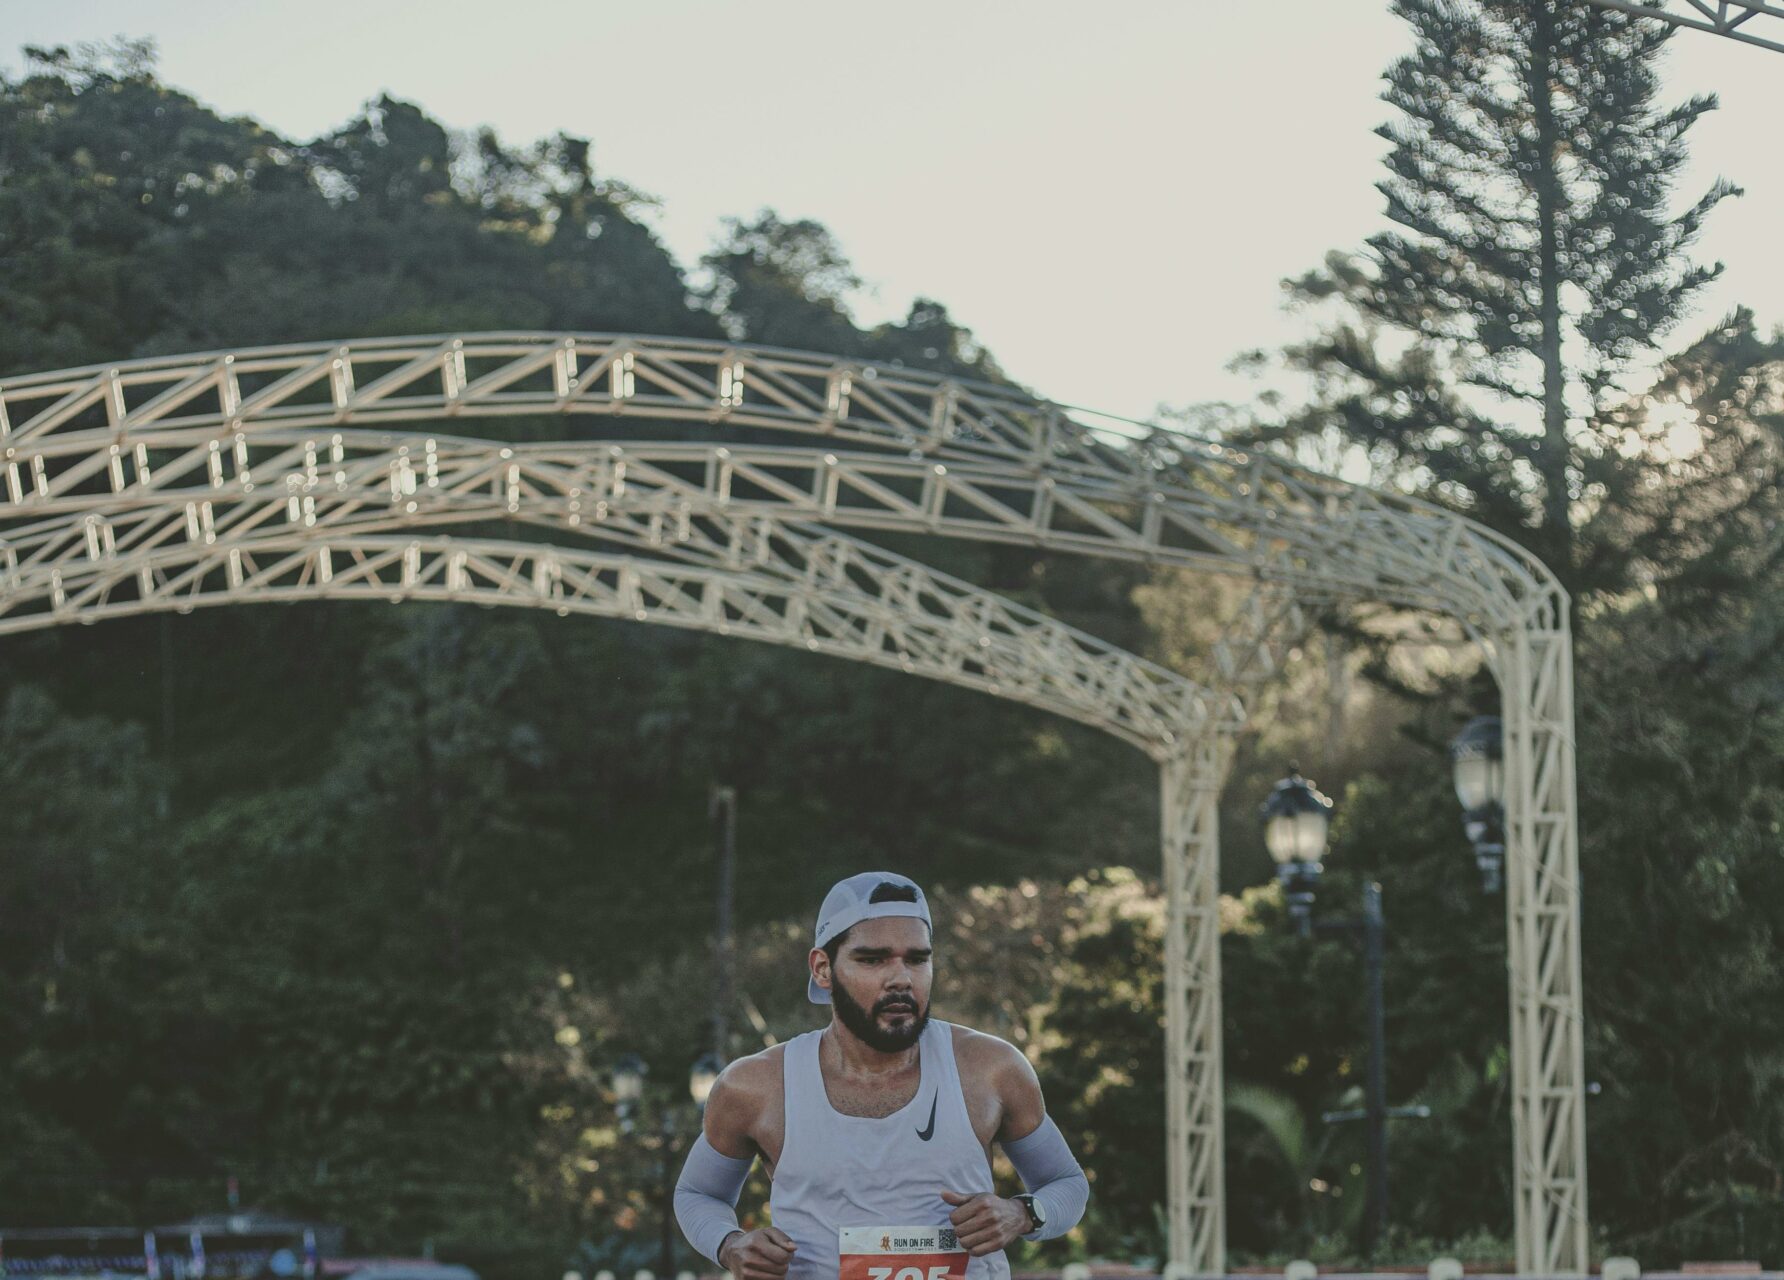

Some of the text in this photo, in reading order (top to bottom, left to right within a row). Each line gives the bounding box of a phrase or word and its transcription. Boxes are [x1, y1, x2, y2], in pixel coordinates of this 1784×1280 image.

[894, 1238, 934, 1247] RUN ON FIRE
